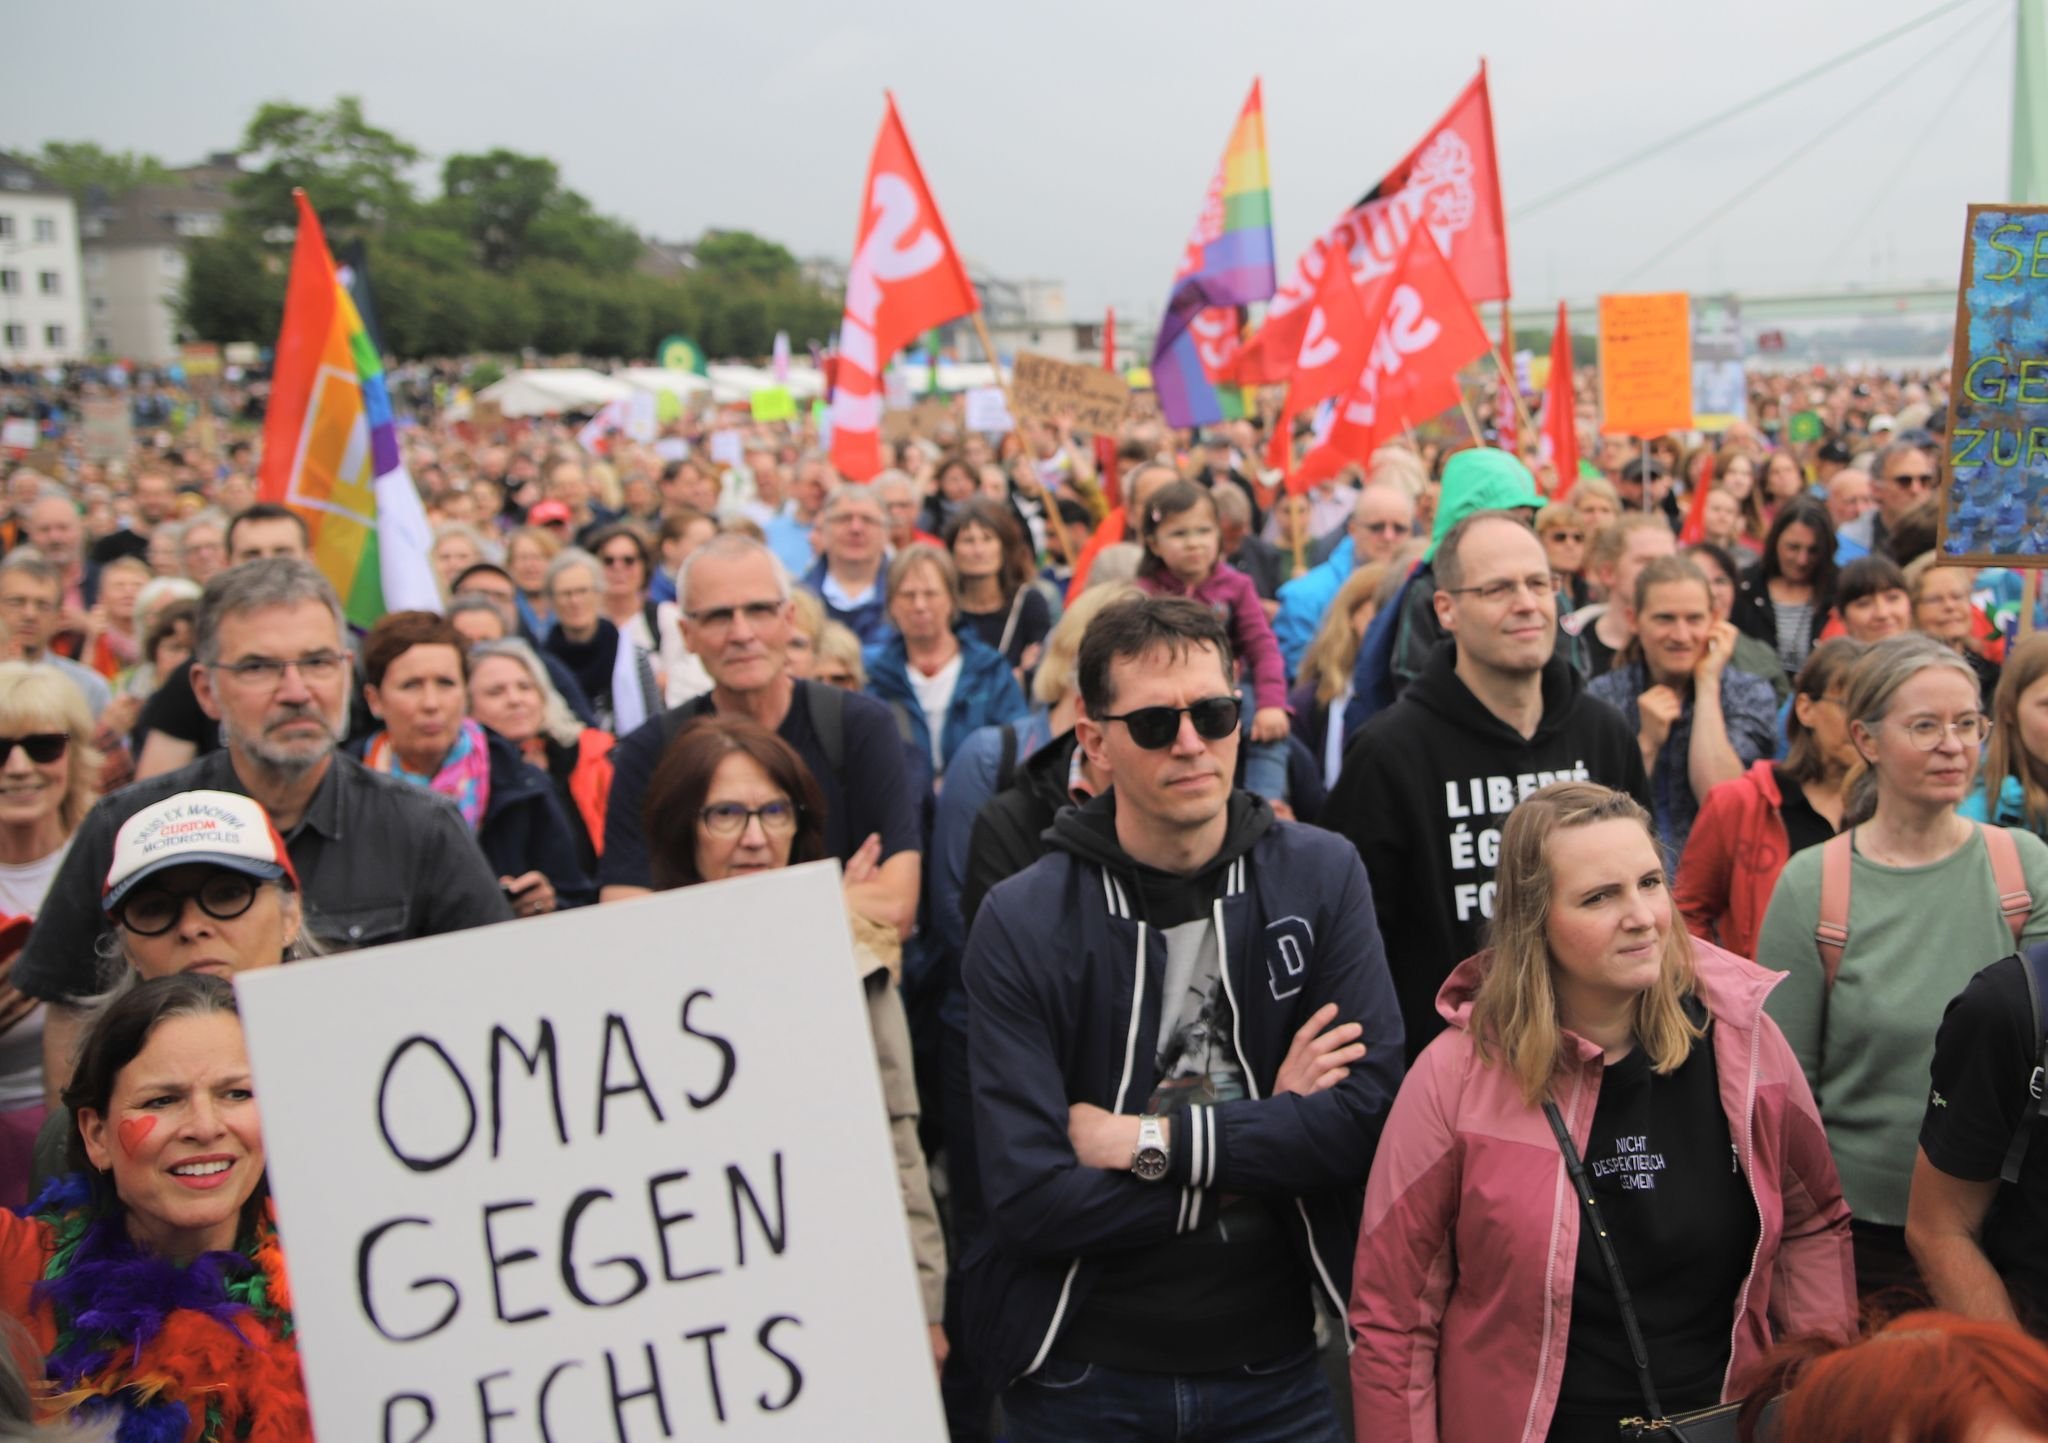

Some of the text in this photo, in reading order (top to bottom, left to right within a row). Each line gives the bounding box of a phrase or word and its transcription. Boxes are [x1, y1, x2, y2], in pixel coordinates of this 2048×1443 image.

[142, 831, 241, 855] MOTORCYCLES
[160, 819, 217, 837] CUSTOM
[1265, 914, 1315, 1001] D
[377, 988, 737, 1174] OMAS
[1615, 1136, 1647, 1154] NICHT
[357, 1151, 785, 1344] GEGEN
